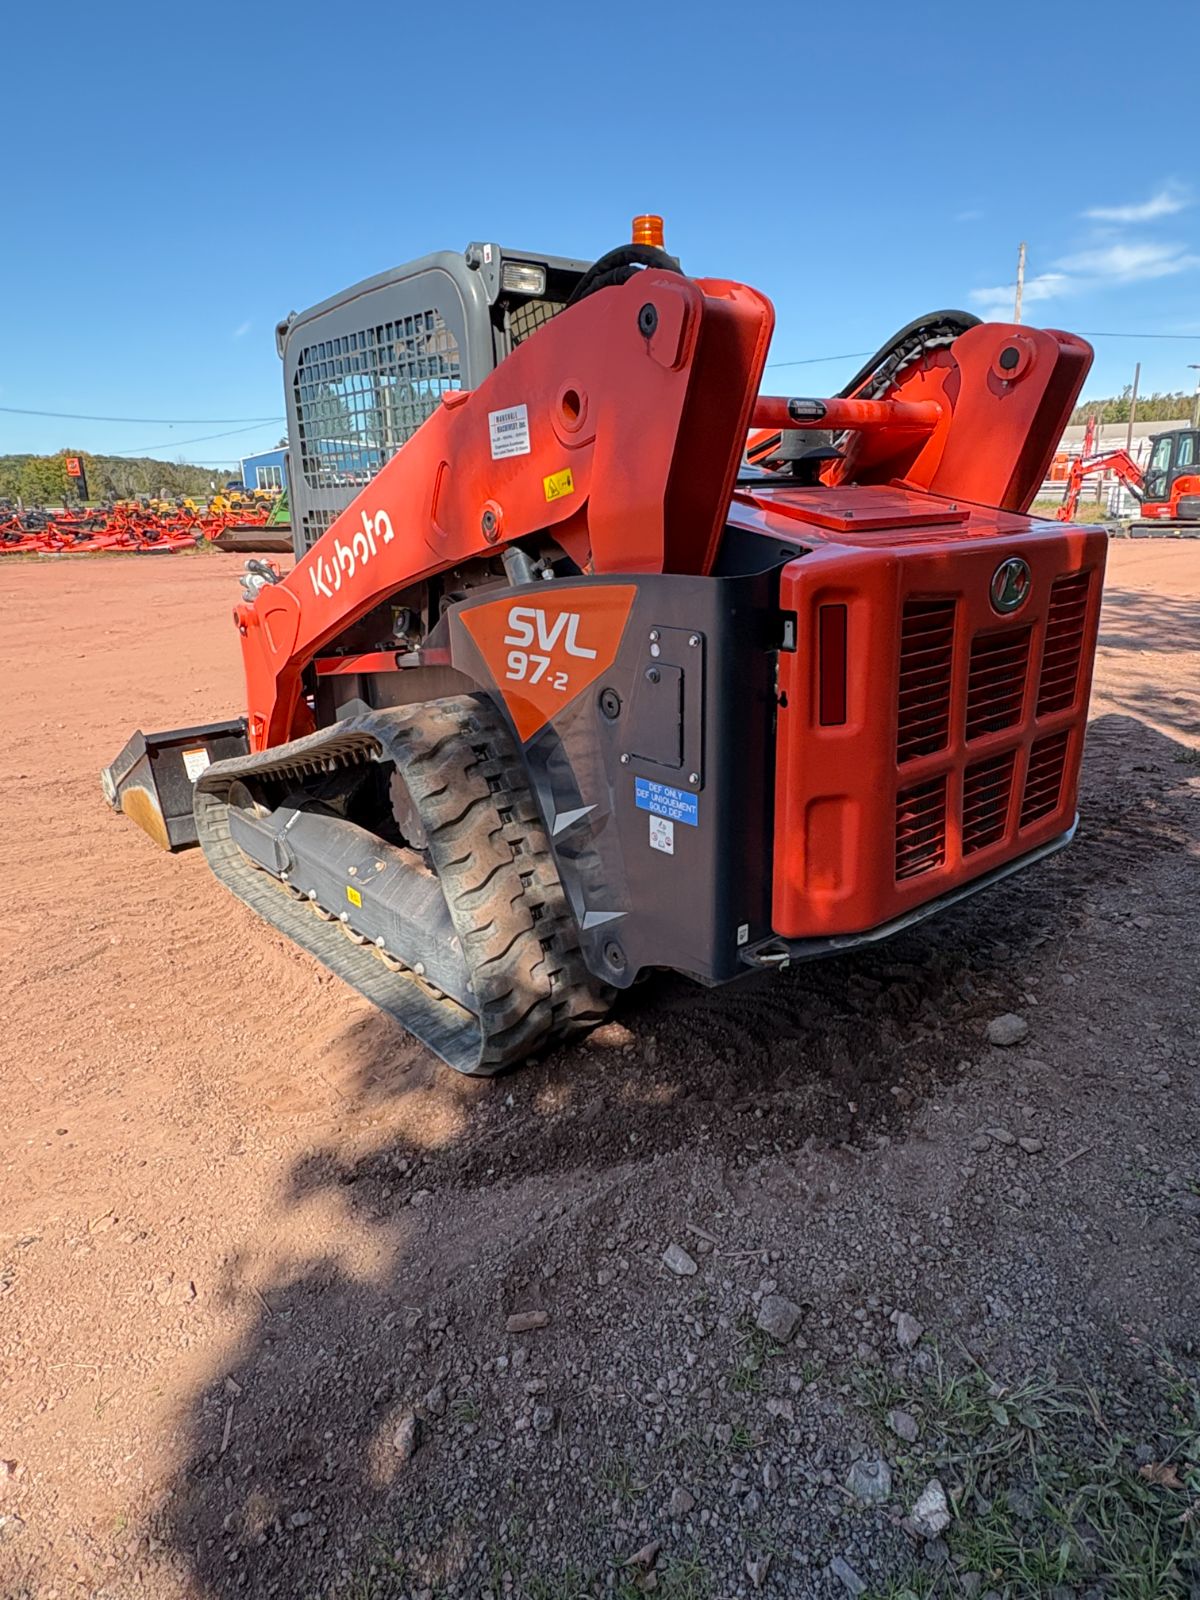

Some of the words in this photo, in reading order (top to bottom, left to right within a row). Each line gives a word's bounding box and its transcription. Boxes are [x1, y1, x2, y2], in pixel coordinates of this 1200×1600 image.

[308, 509, 395, 598] Kubota
[503, 606, 597, 660] SVL
[505, 650, 569, 691] 97-2
[637, 789, 649, 798] DEF
[651, 793, 696, 814] UNIQUEMENT
[648, 782, 662, 794] DEF
[664, 787, 683, 800] ONLY
[649, 801, 667, 814] SOLO
[668, 807, 683, 818] DEF
